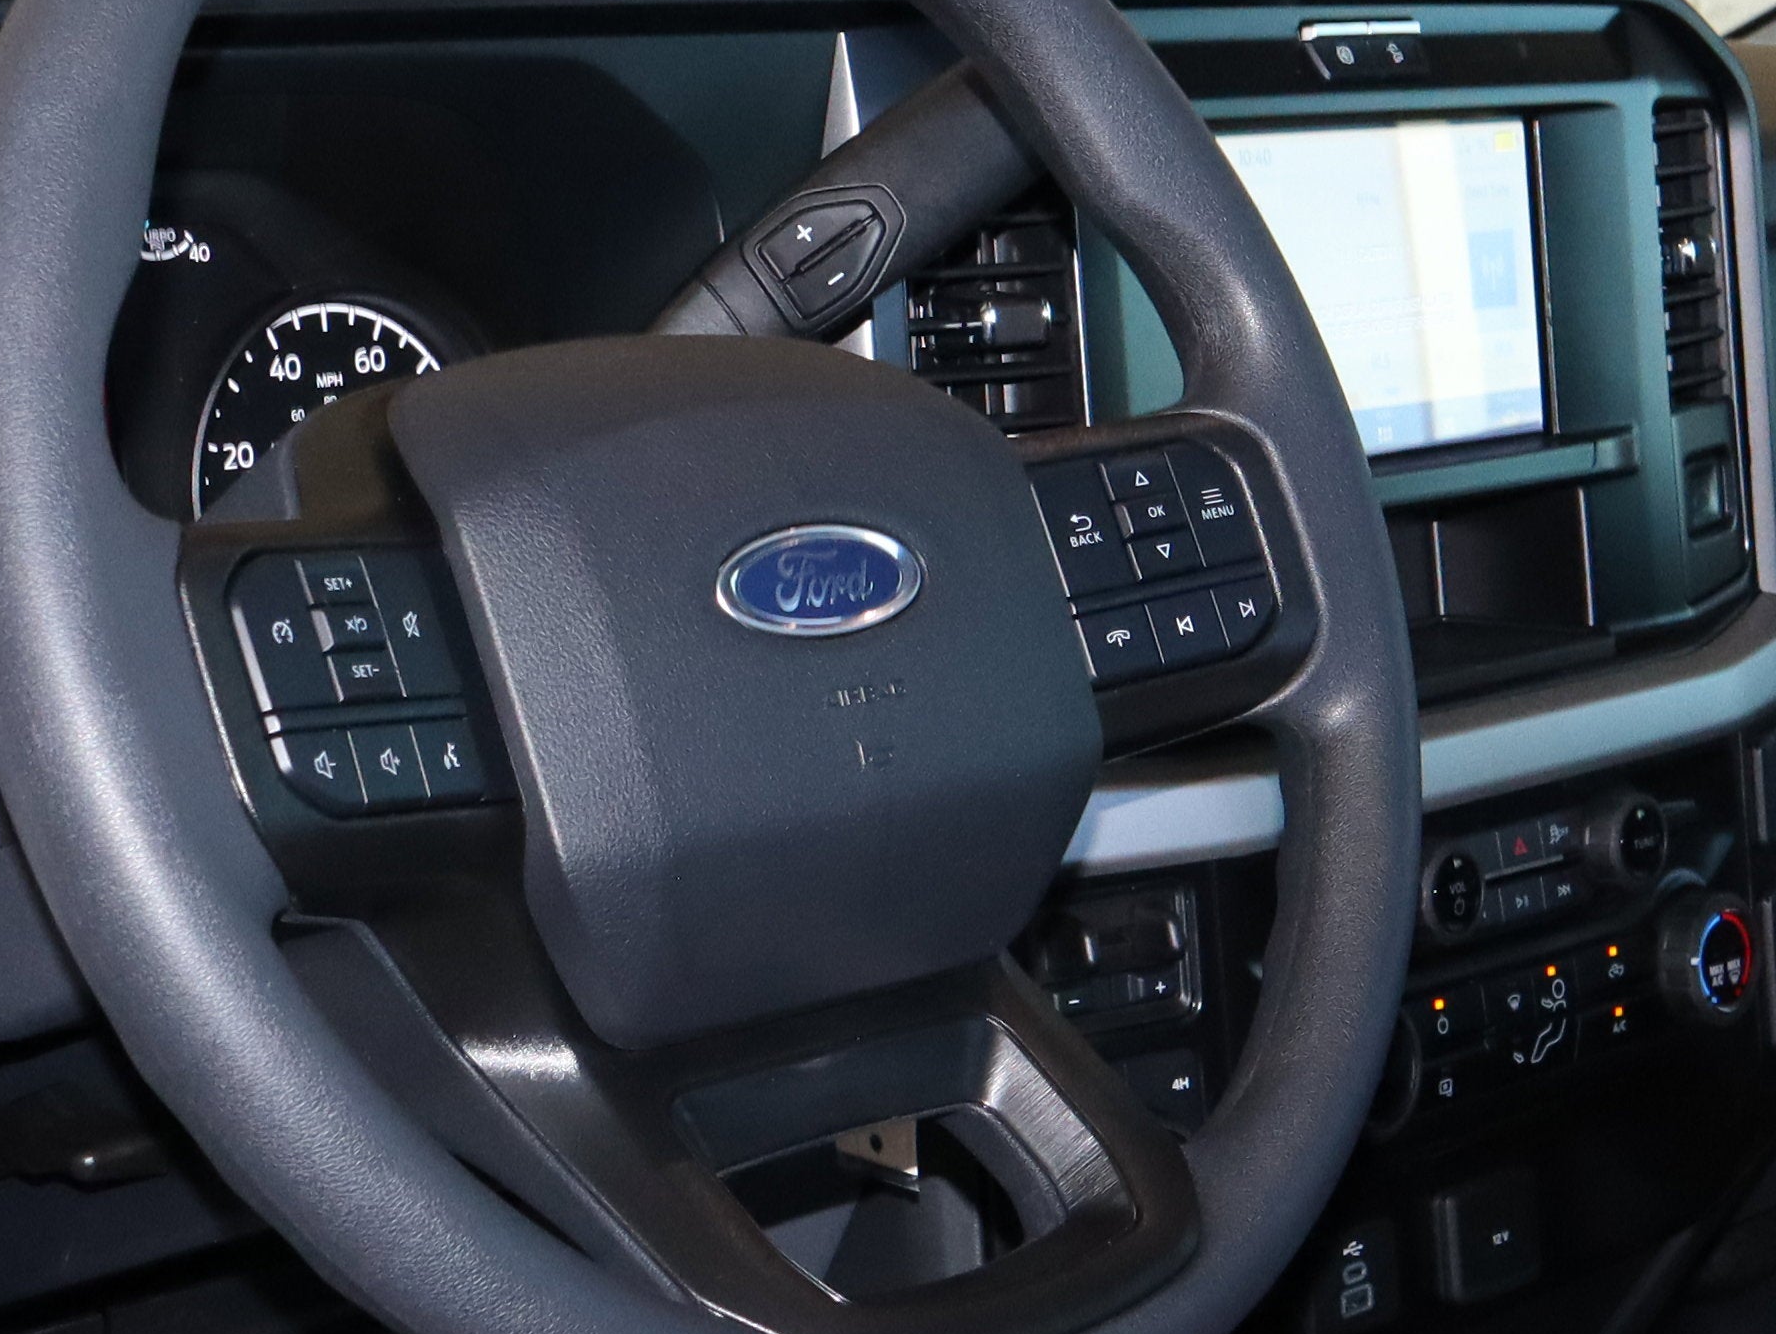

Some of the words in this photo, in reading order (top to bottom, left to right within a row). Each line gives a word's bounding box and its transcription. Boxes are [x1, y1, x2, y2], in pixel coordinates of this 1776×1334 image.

[189, 242, 210, 262] 40
[269, 353, 302, 382] 40
[354, 345, 386, 374] 60
[316, 371, 344, 389] MPH
[291, 408, 306, 422] 60
[223, 441, 255, 471] 20
[1147, 505, 1167, 519] OK
[1201, 504, 1236, 521] MENU
[1069, 531, 1105, 549] BACK
[775, 548, 874, 612] Ford
[1172, 1076, 1190, 1091] 4H
